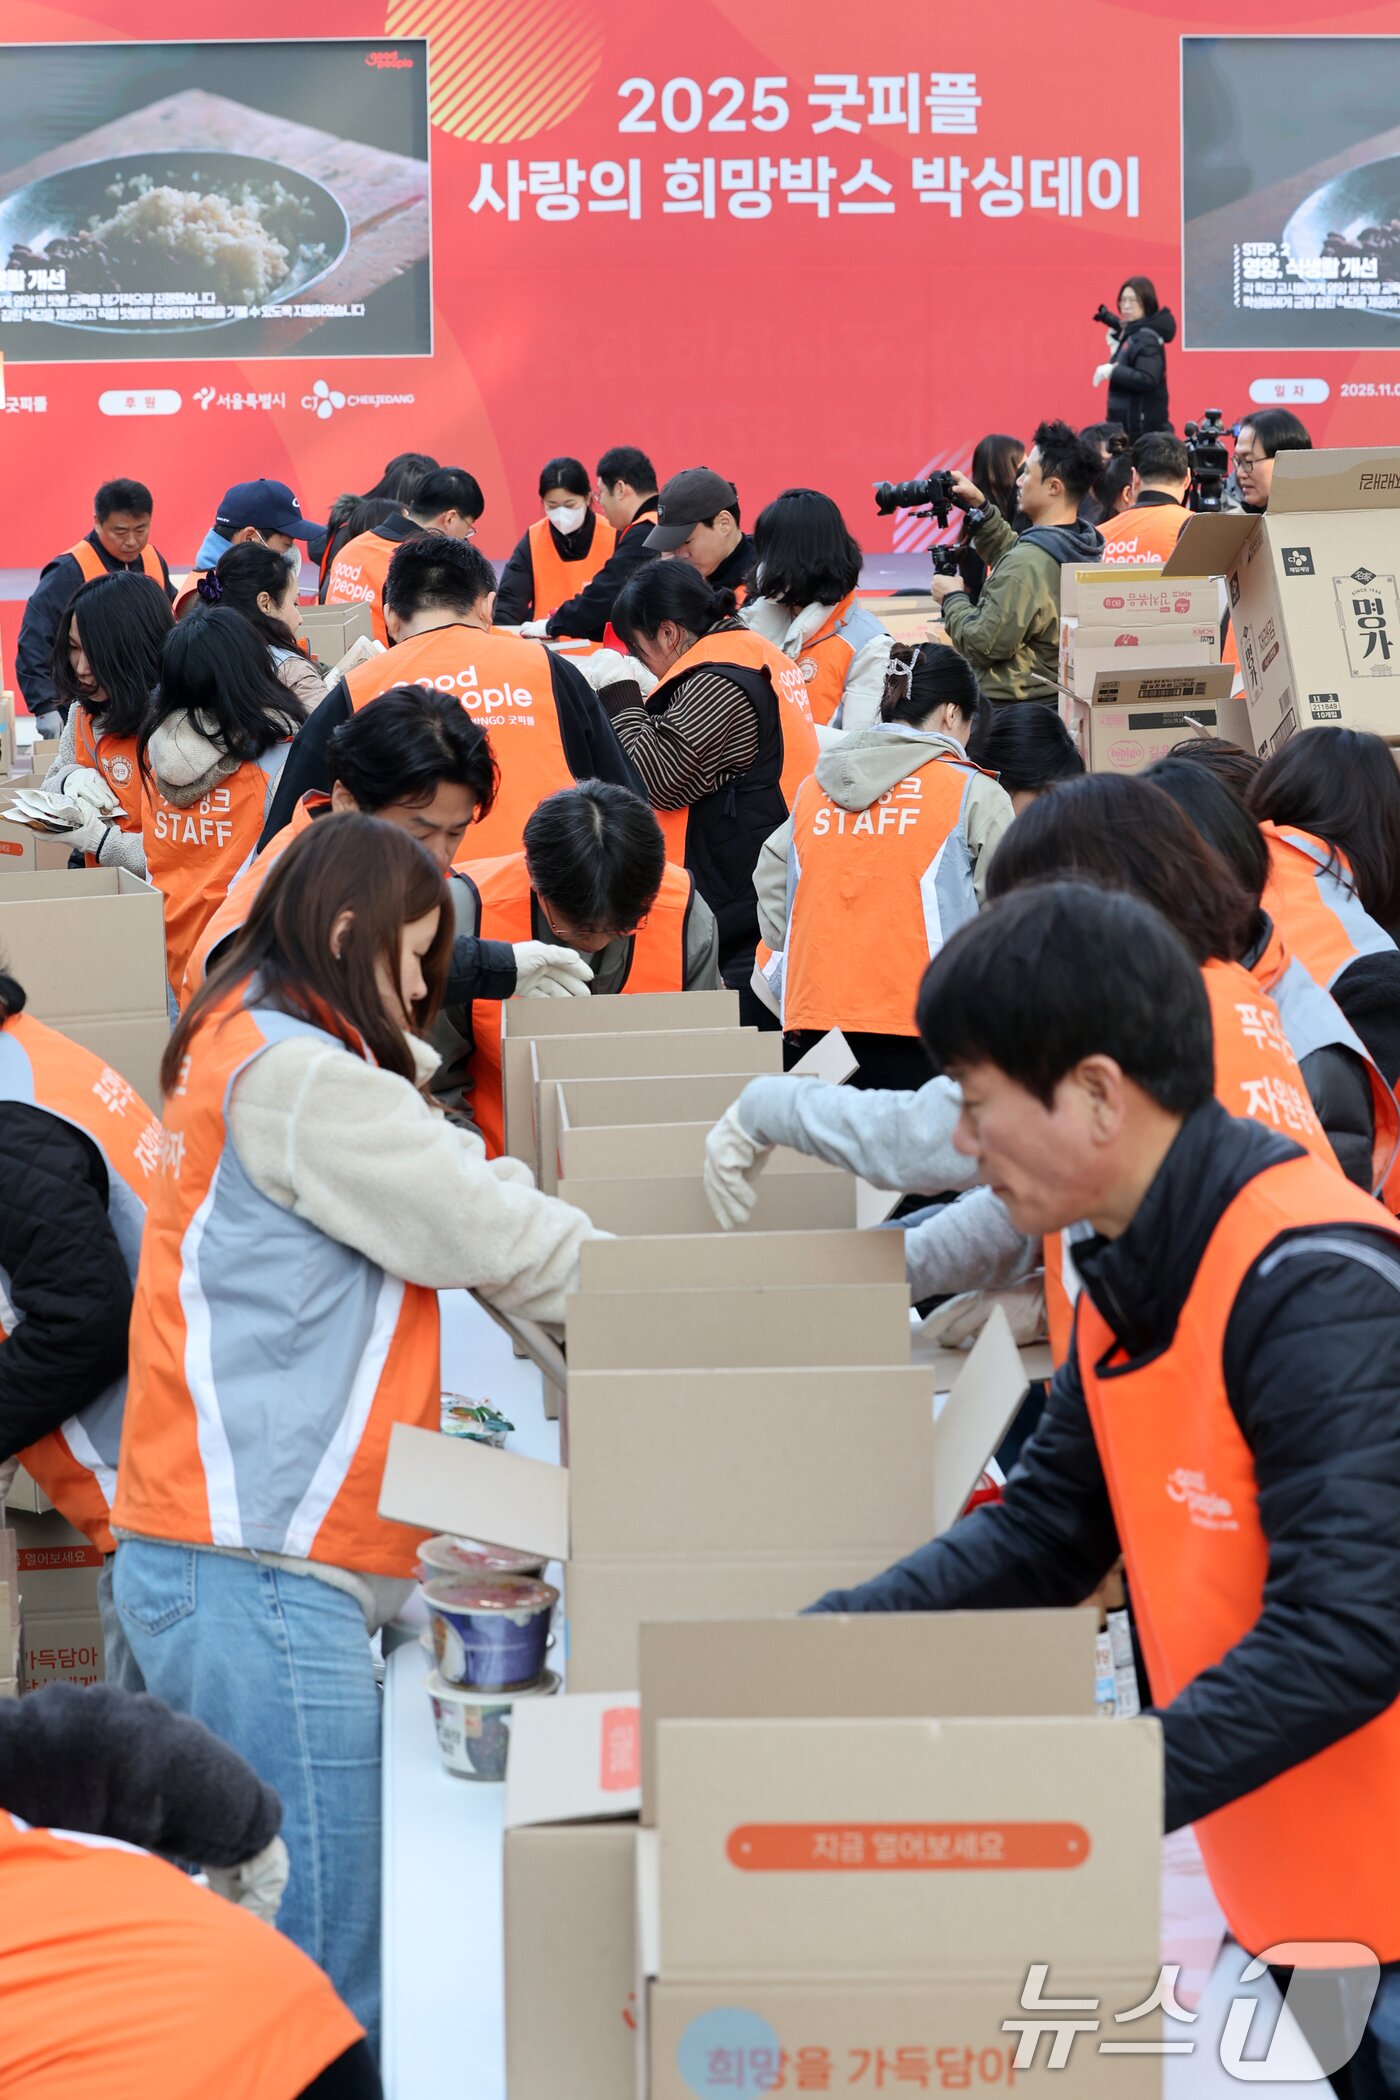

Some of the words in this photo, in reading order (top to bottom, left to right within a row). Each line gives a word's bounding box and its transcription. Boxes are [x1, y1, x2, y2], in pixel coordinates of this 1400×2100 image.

[617, 77, 790, 133] 2025
[808, 73, 983, 135] 굿피플
[468, 159, 642, 221] 사랑의
[662, 157, 896, 219] 희망박스
[911, 156, 1140, 218] 박싱데이
[27, 269, 66, 291] 개선
[1341, 257, 1378, 278] 개선
[216, 391, 286, 411] 서울특별시
[301, 396, 318, 411] CJ
[332, 578, 376, 603] people
[1352, 598, 1394, 660] 명가
[154, 810, 233, 848] STAFF
[812, 807, 921, 836] STAFF
[25, 1550, 87, 1567] 열어보세요
[811, 1830, 865, 1863] 지금
[870, 1830, 1006, 1863] 열어보세요
[705, 2046, 836, 2091] 희망을
